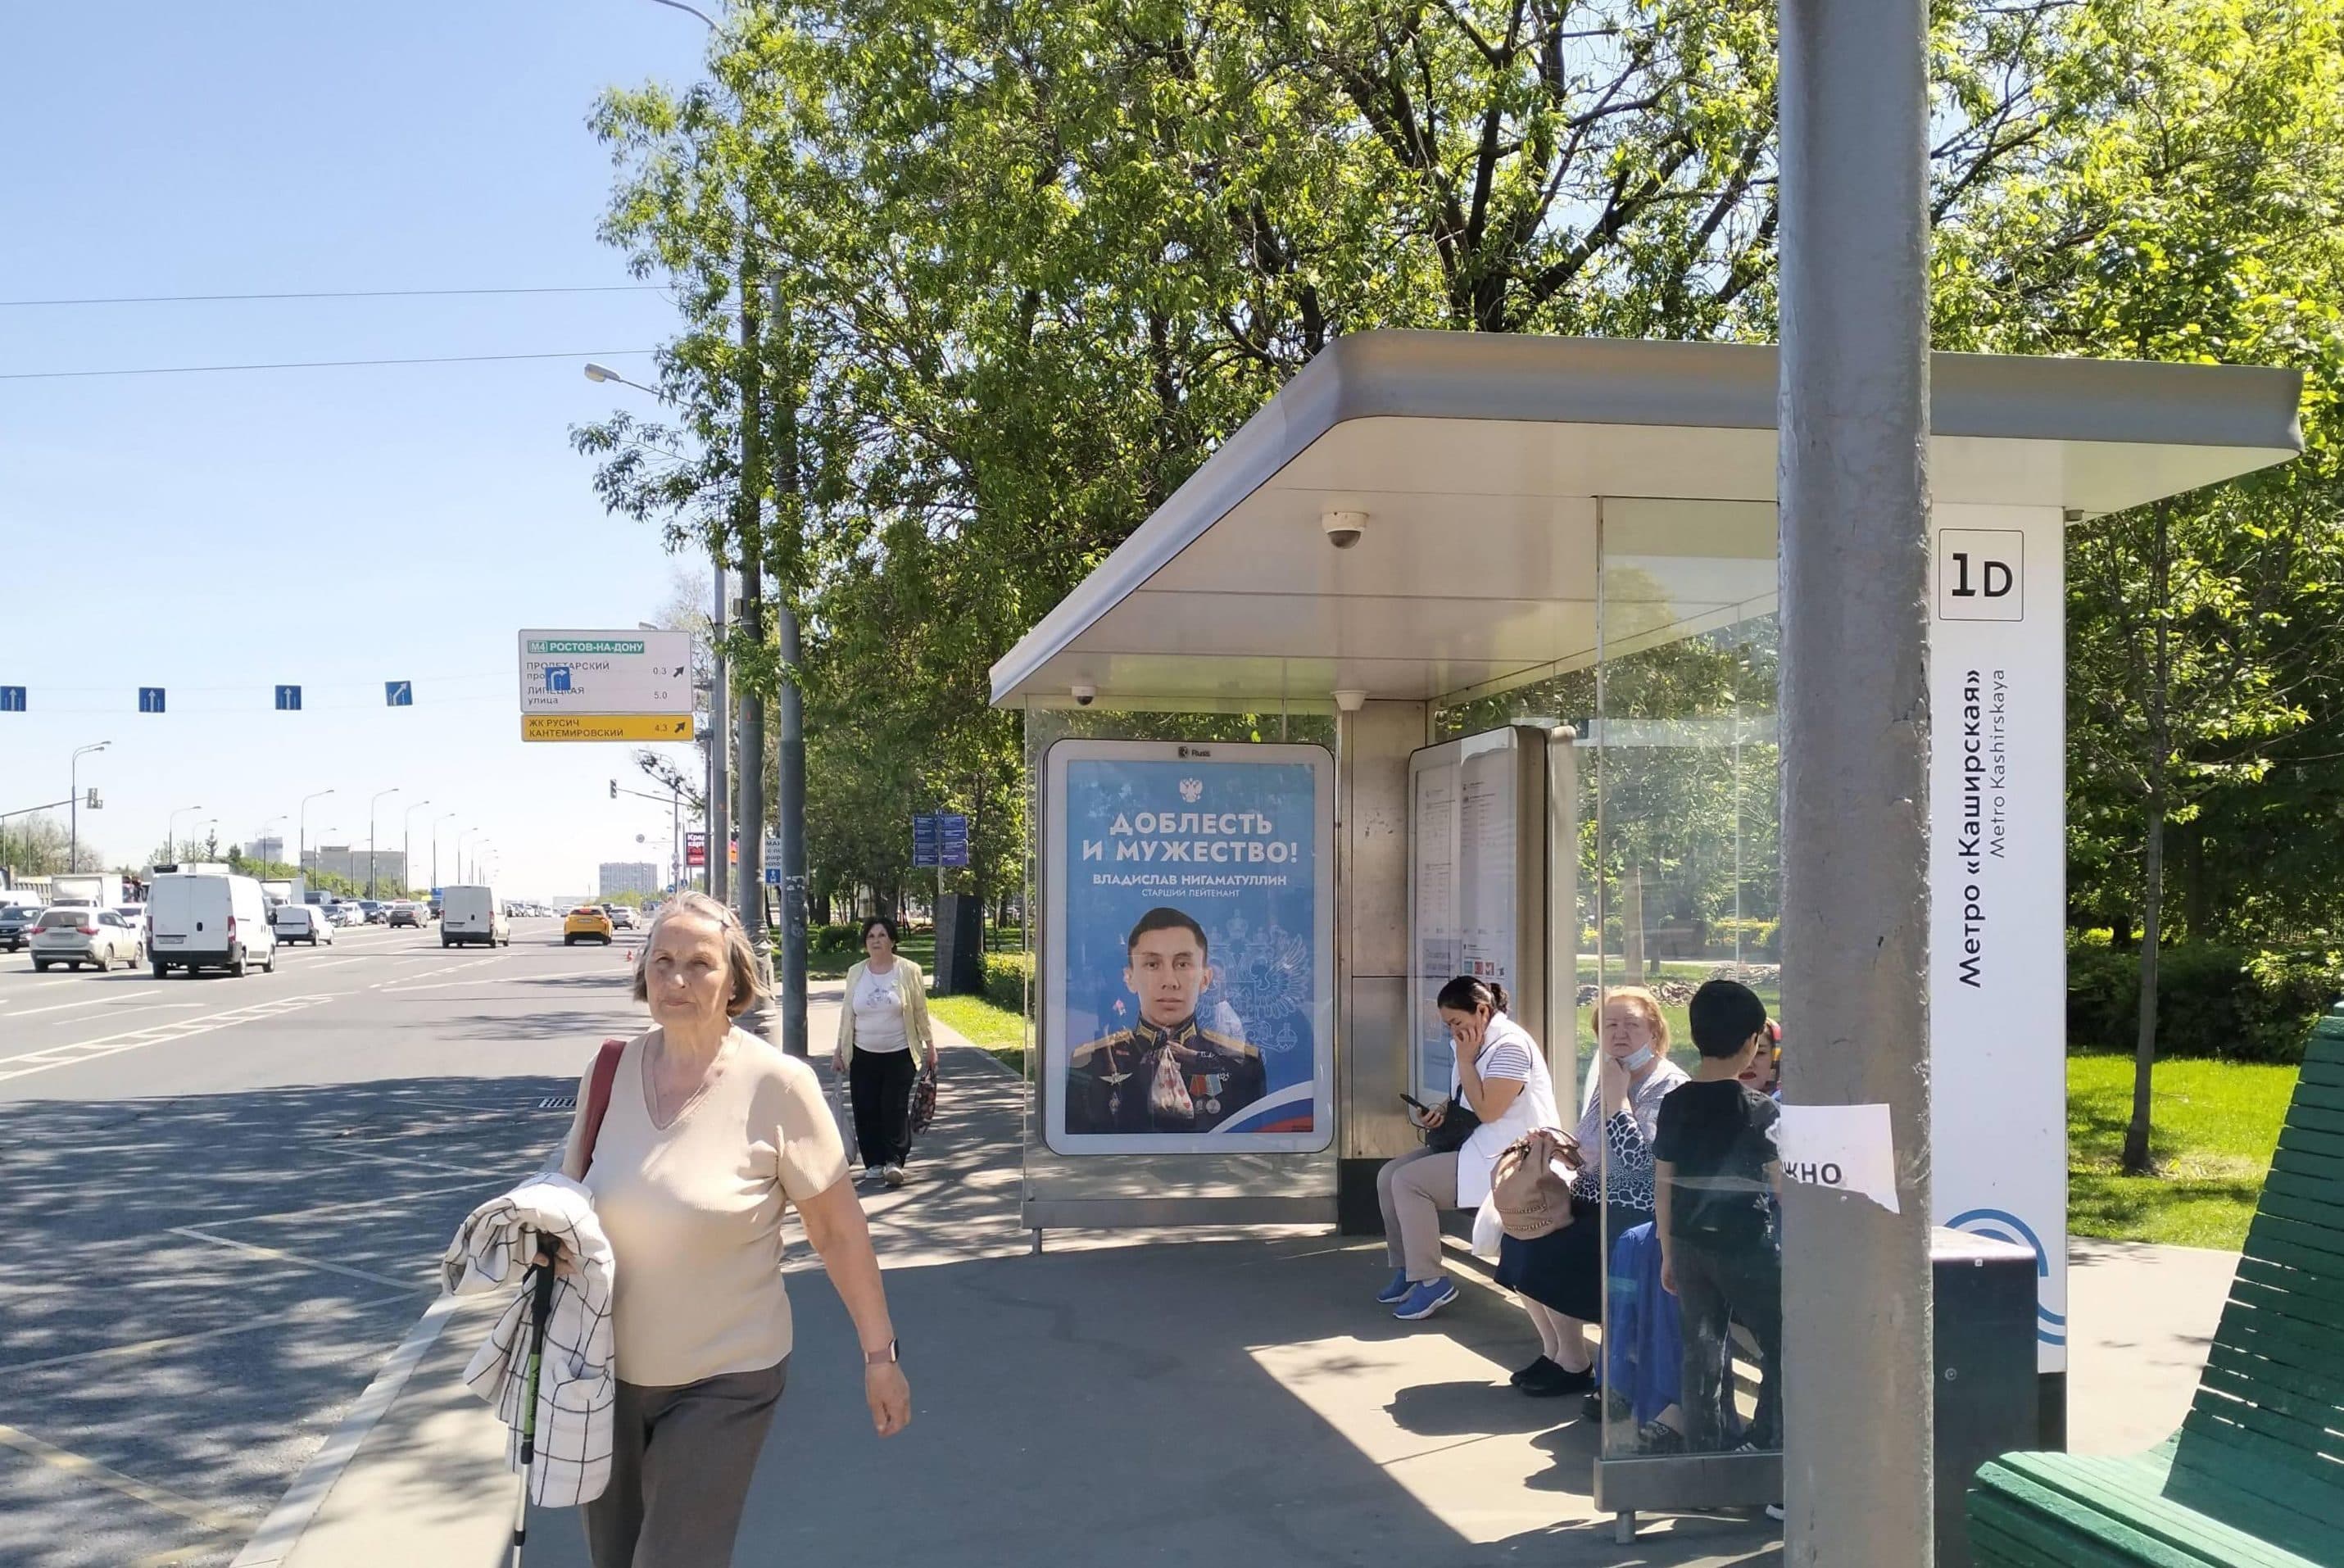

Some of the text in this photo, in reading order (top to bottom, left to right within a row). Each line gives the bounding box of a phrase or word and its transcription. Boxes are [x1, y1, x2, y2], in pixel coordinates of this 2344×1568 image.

[1952, 552, 2013, 597] 1D
[550, 642, 643, 654] РОСТОВ-НА-ДОНУ
[528, 697, 558, 705] улица
[654, 691, 668, 700] 5.0
[529, 718, 546, 727] ЖК
[546, 718, 579, 727] РУСИЧ
[529, 727, 623, 737] КАНТЕМИРОВСКИЙ
[1989, 668, 2007, 859] Metro Kashirskaya
[1109, 812, 1272, 836] ДОБЛЕСТЬ
[1958, 669, 1986, 988] Метро «Каширская»
[1082, 840, 1298, 863] И МУЖЕСТВО!
[1093, 874, 1287, 886] ВЛАДИСЛАВ НИГАМАТУЛЛИН
[1781, 1161, 1843, 1185] ЖНО
